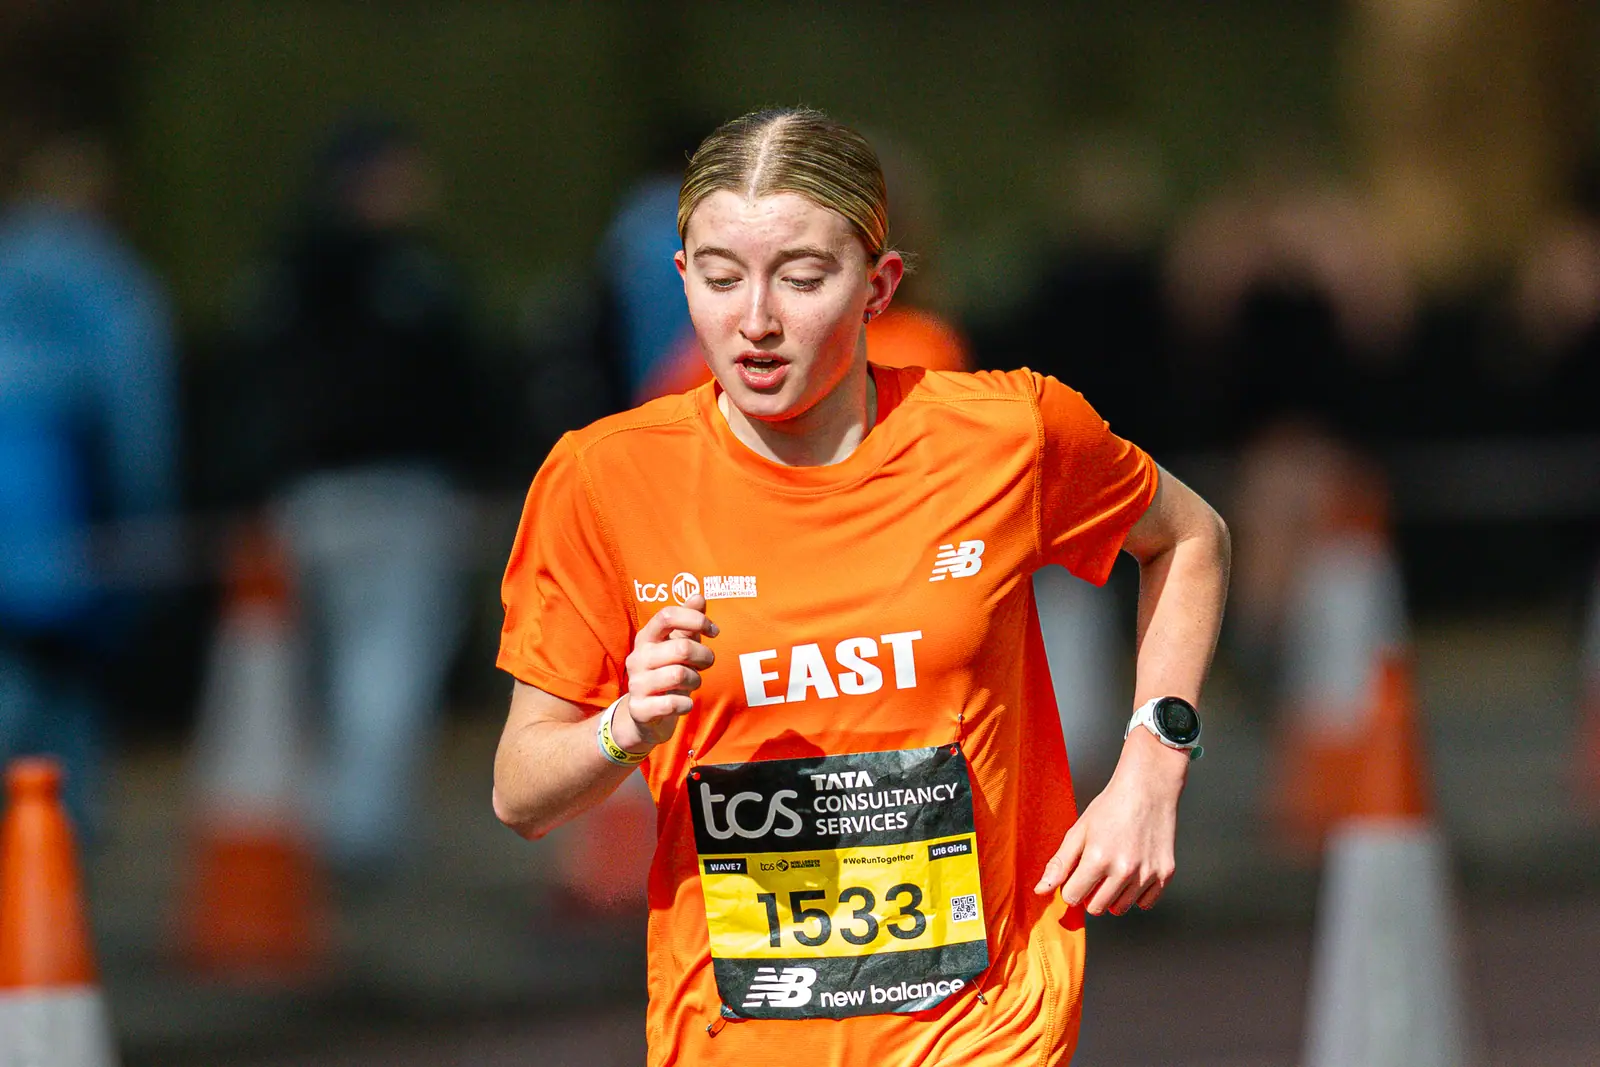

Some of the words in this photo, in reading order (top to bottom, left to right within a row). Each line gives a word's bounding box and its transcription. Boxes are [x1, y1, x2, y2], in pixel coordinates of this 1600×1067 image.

[633, 579, 669, 602] tcs
[738, 630, 923, 707] EAST
[810, 770, 874, 791] TATA
[813, 782, 959, 814] CONSULTANCY
[700, 782, 803, 840] tcs
[816, 811, 909, 836] SERVICES
[842, 854, 914, 864] #WeRunTogether
[931, 847, 947, 856] U16
[947, 843, 968, 854] Girls
[759, 861, 775, 872] tcs
[756, 882, 928, 948] 1533
[820, 989, 869, 1008] new
[870, 978, 966, 1004] balance
